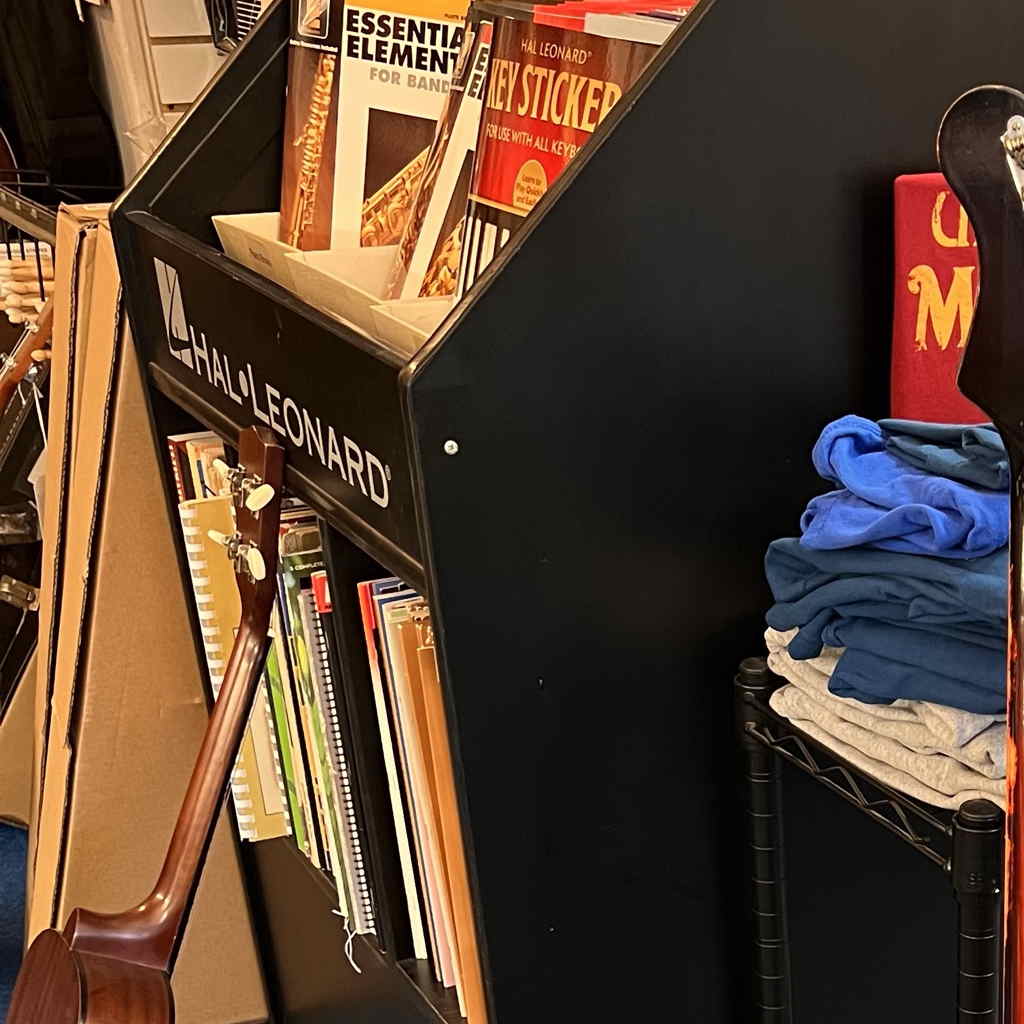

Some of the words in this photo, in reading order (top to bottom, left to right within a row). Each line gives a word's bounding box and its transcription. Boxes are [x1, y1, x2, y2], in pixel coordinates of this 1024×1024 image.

[346, 8, 465, 49] ESSENTIA
[521, 38, 537, 55] HAL
[370, 67, 401, 85] FOR
[407, 74, 450, 94] BAND
[486, 58, 520, 113] KEY
[486, 123, 498, 139] FOR
[498, 126, 511, 142] USE
[512, 129, 533, 147] WITH
[534, 137, 549, 153] ALL
[189, 325, 243, 405] HAL
